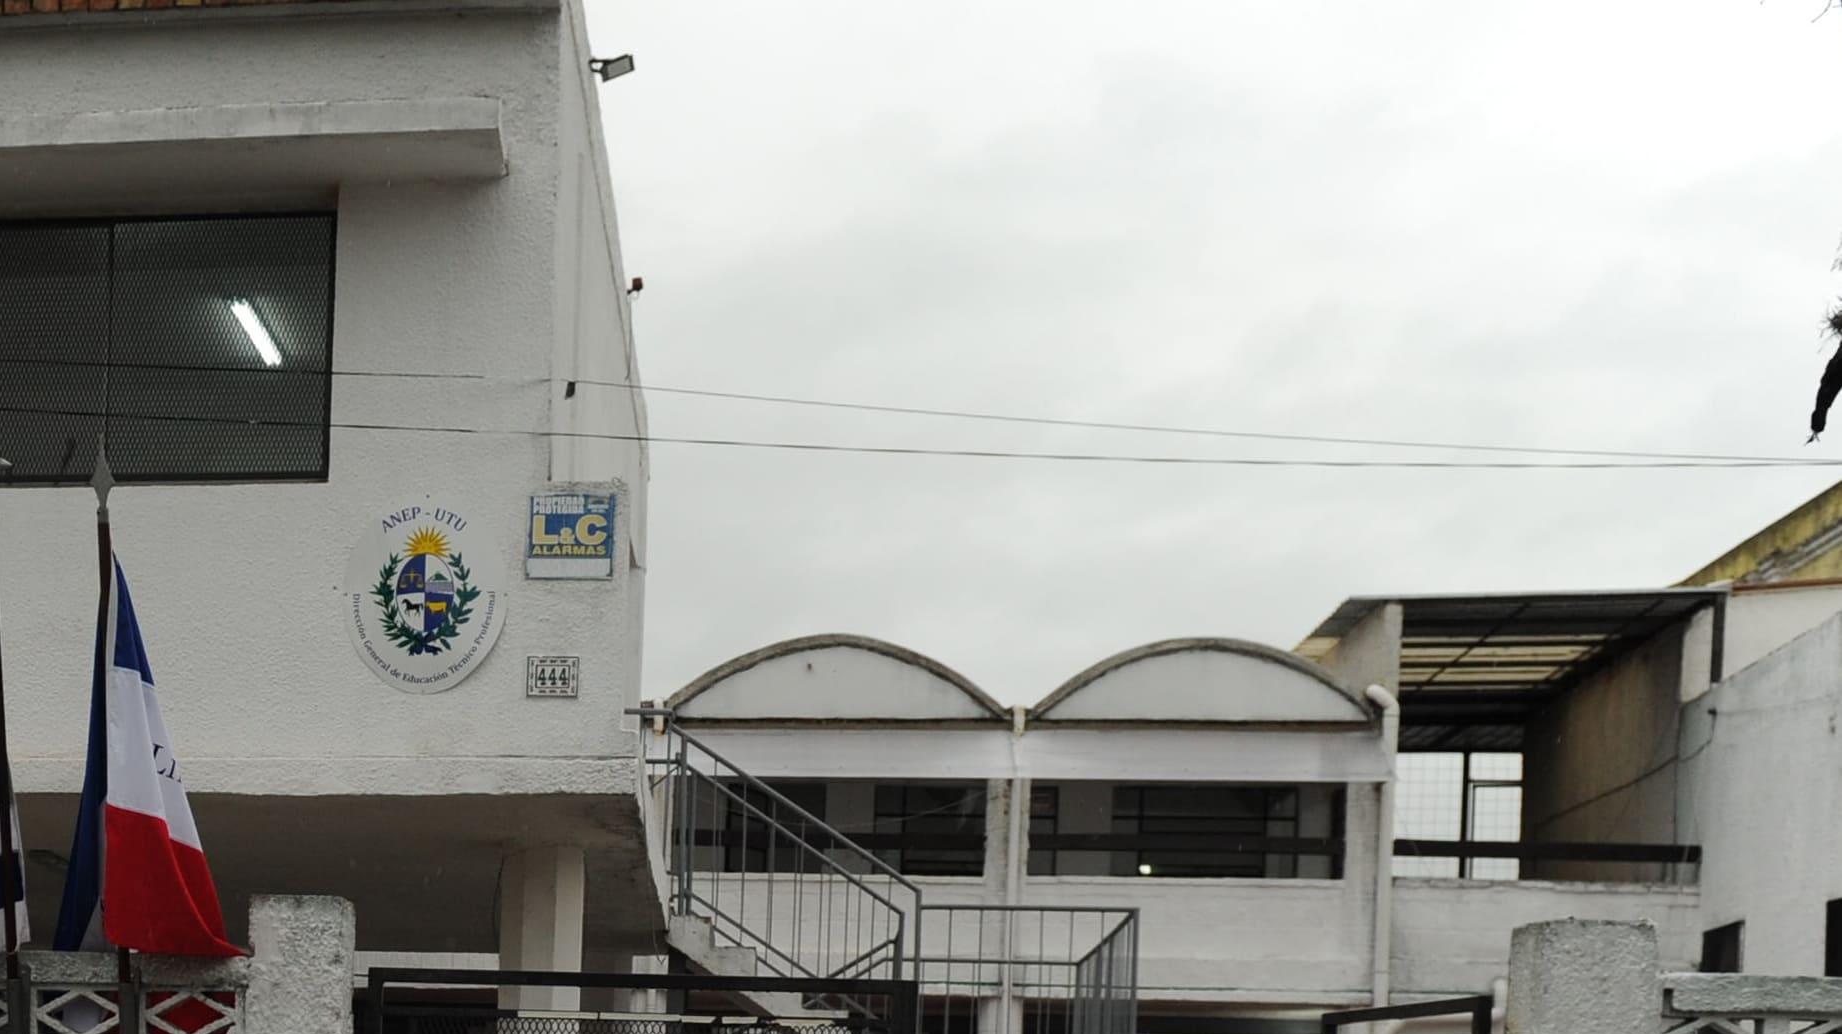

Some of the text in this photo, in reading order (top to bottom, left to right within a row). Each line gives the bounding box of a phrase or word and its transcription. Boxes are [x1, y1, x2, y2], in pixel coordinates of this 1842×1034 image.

[382, 506, 421, 534] ANEP
[434, 508, 467, 532] UTU
[532, 514, 607, 545] L&C
[532, 545, 607, 555] ALARMAS
[352, 593, 368, 640] Dirección
[364, 640, 391, 672] General
[389, 668, 401, 679] de
[402, 671, 448, 684] Educación
[473, 591, 496, 646] Profesional
[537, 667, 568, 686] 444
